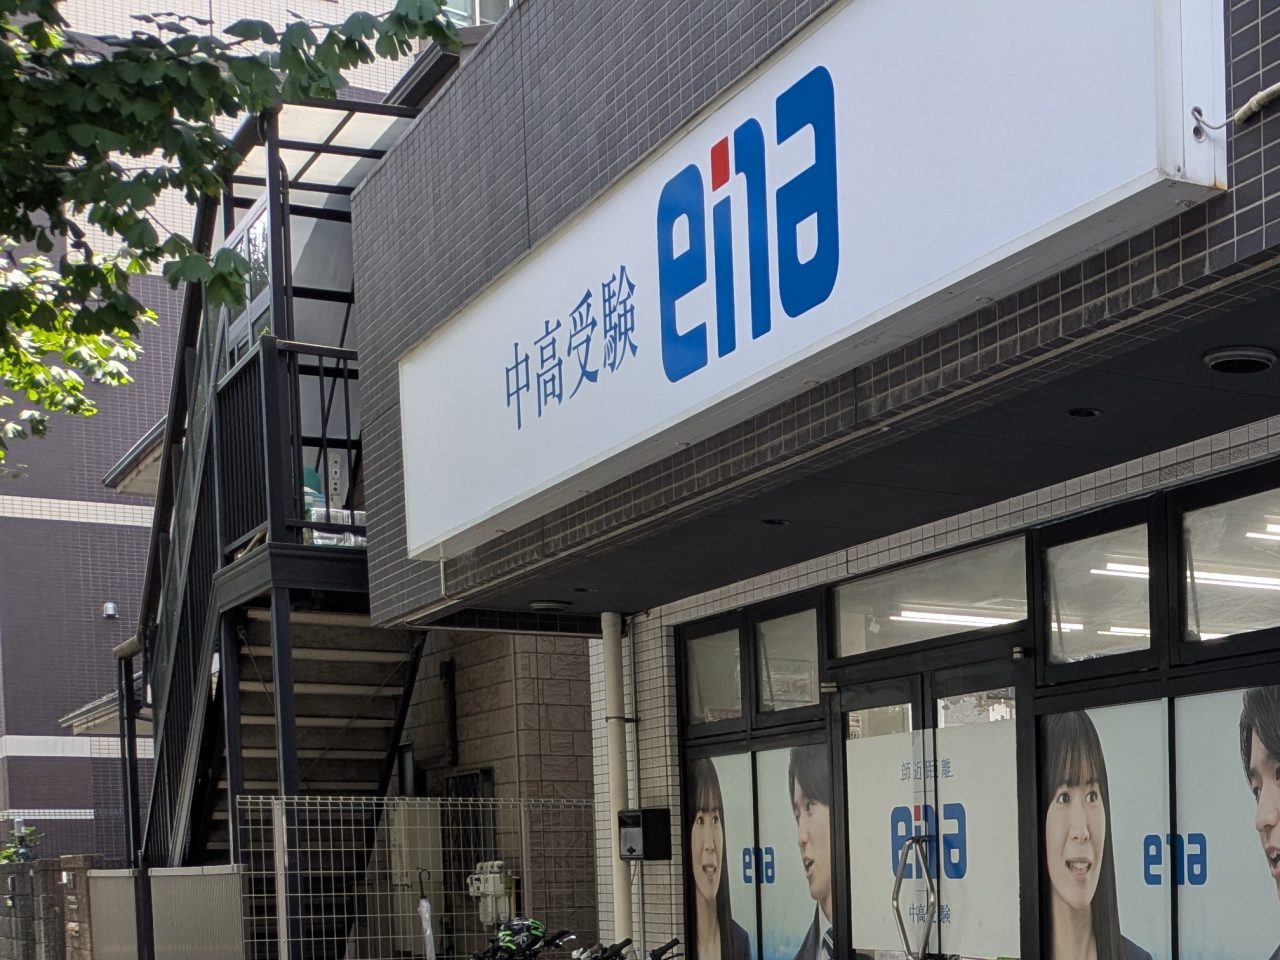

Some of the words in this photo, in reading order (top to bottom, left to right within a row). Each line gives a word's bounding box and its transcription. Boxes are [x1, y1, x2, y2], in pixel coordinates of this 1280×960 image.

[657, 65, 839, 382] ena
[505, 265, 638, 430] 中高受験
[891, 803, 967, 879] ena
[909, 903, 951, 924] 中高験
